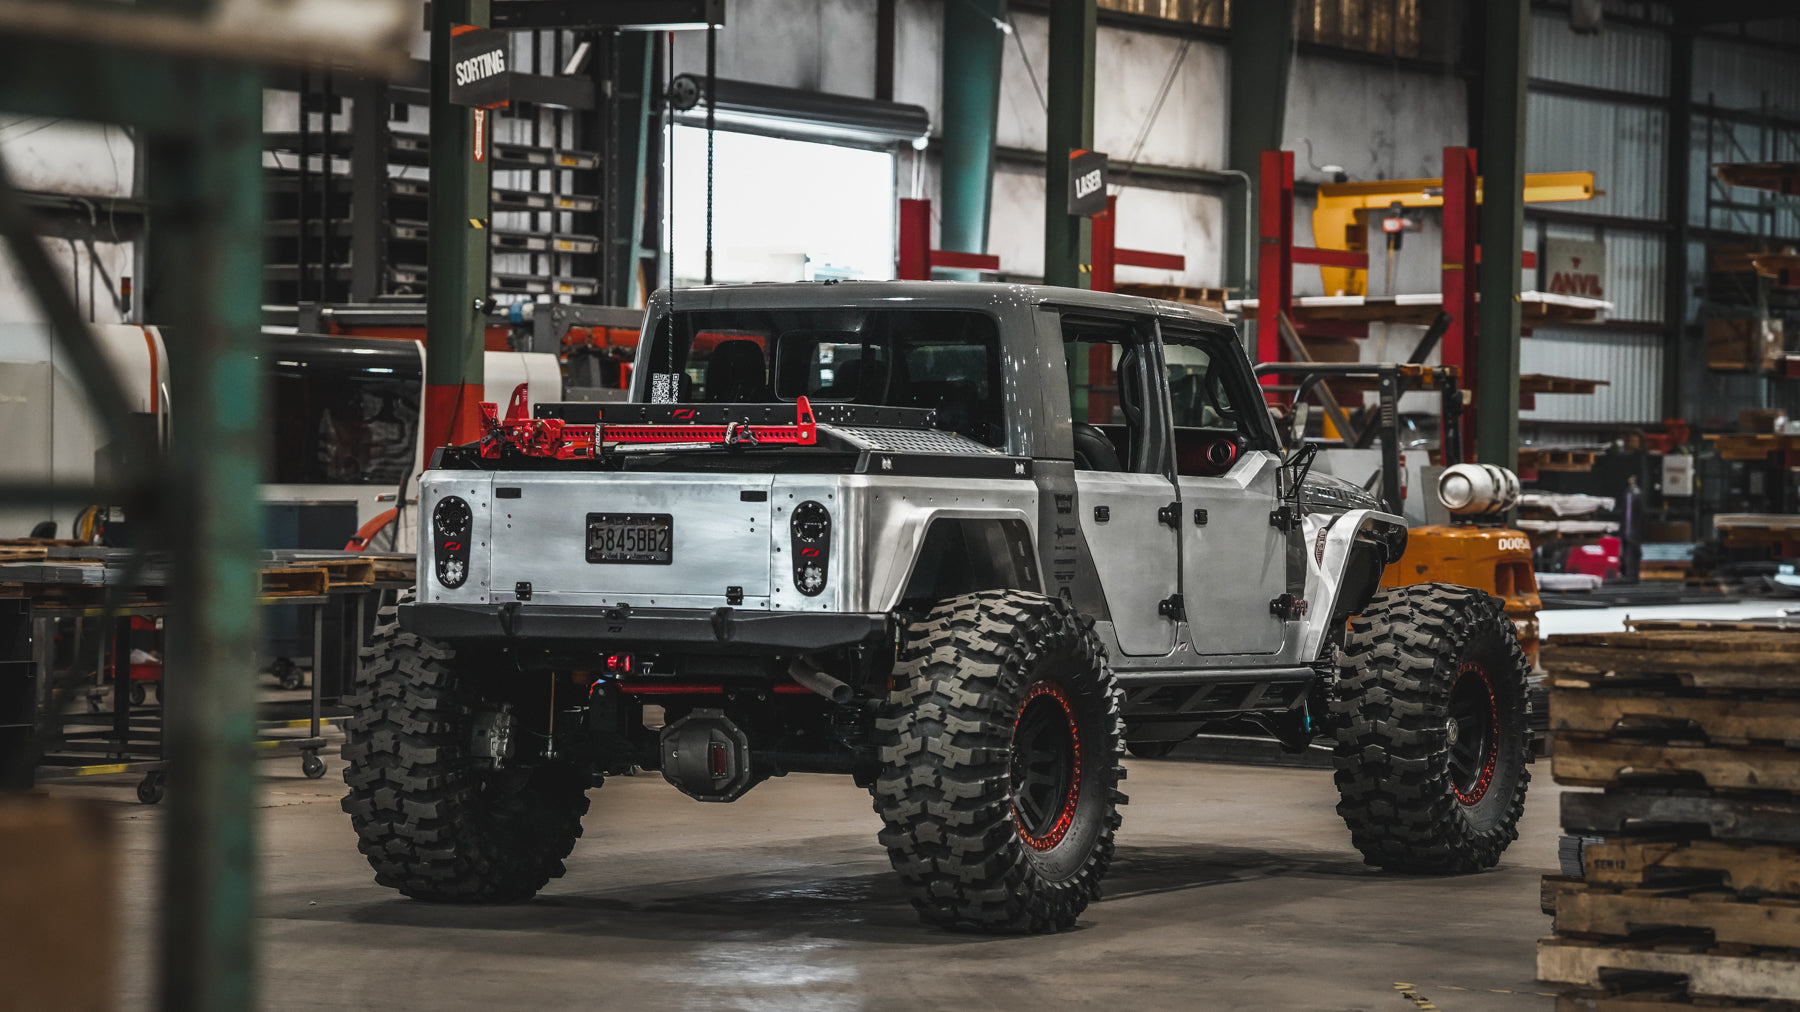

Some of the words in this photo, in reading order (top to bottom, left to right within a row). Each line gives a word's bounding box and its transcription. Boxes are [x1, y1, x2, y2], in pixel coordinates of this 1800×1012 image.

[455, 48, 505, 86] SORTING
[1075, 168, 1102, 199] LASER
[595, 528, 667, 552] 5845BB2
